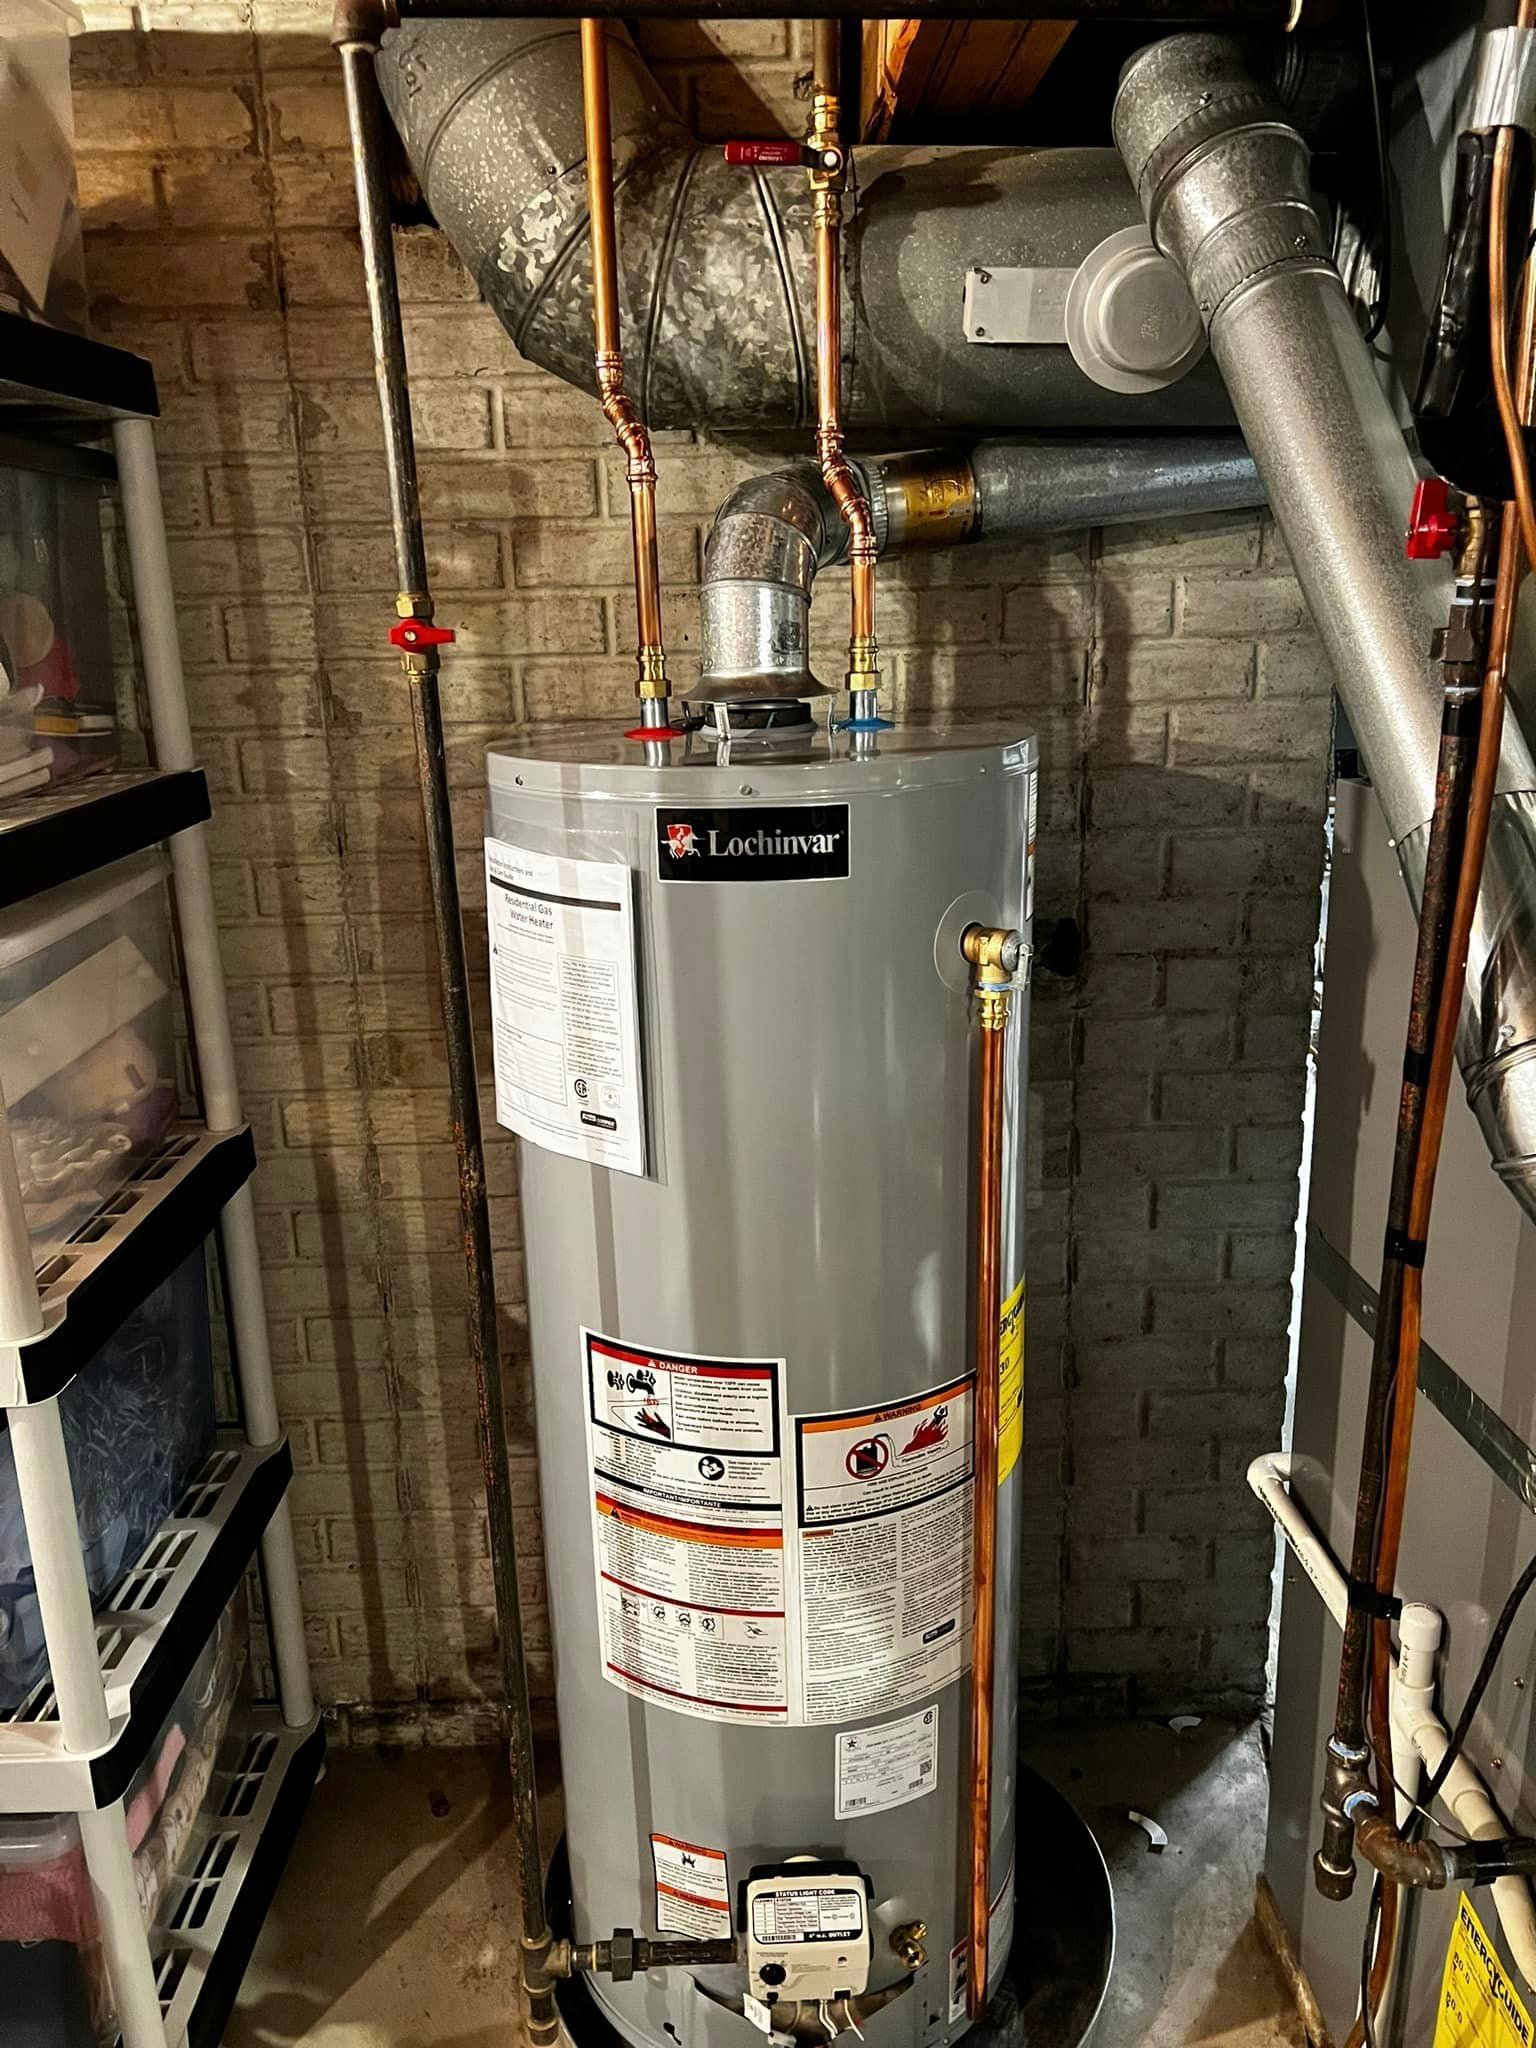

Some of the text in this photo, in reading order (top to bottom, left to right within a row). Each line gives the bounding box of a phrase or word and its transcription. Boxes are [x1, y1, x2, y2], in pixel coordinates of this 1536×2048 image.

[706, 829, 840, 857] Lochinvar
[504, 893, 553, 916] Residential Gas
[510, 908, 554, 930] Water Heater
[659, 1361, 698, 1375] DANGER
[882, 1404, 922, 1420] WARNING
